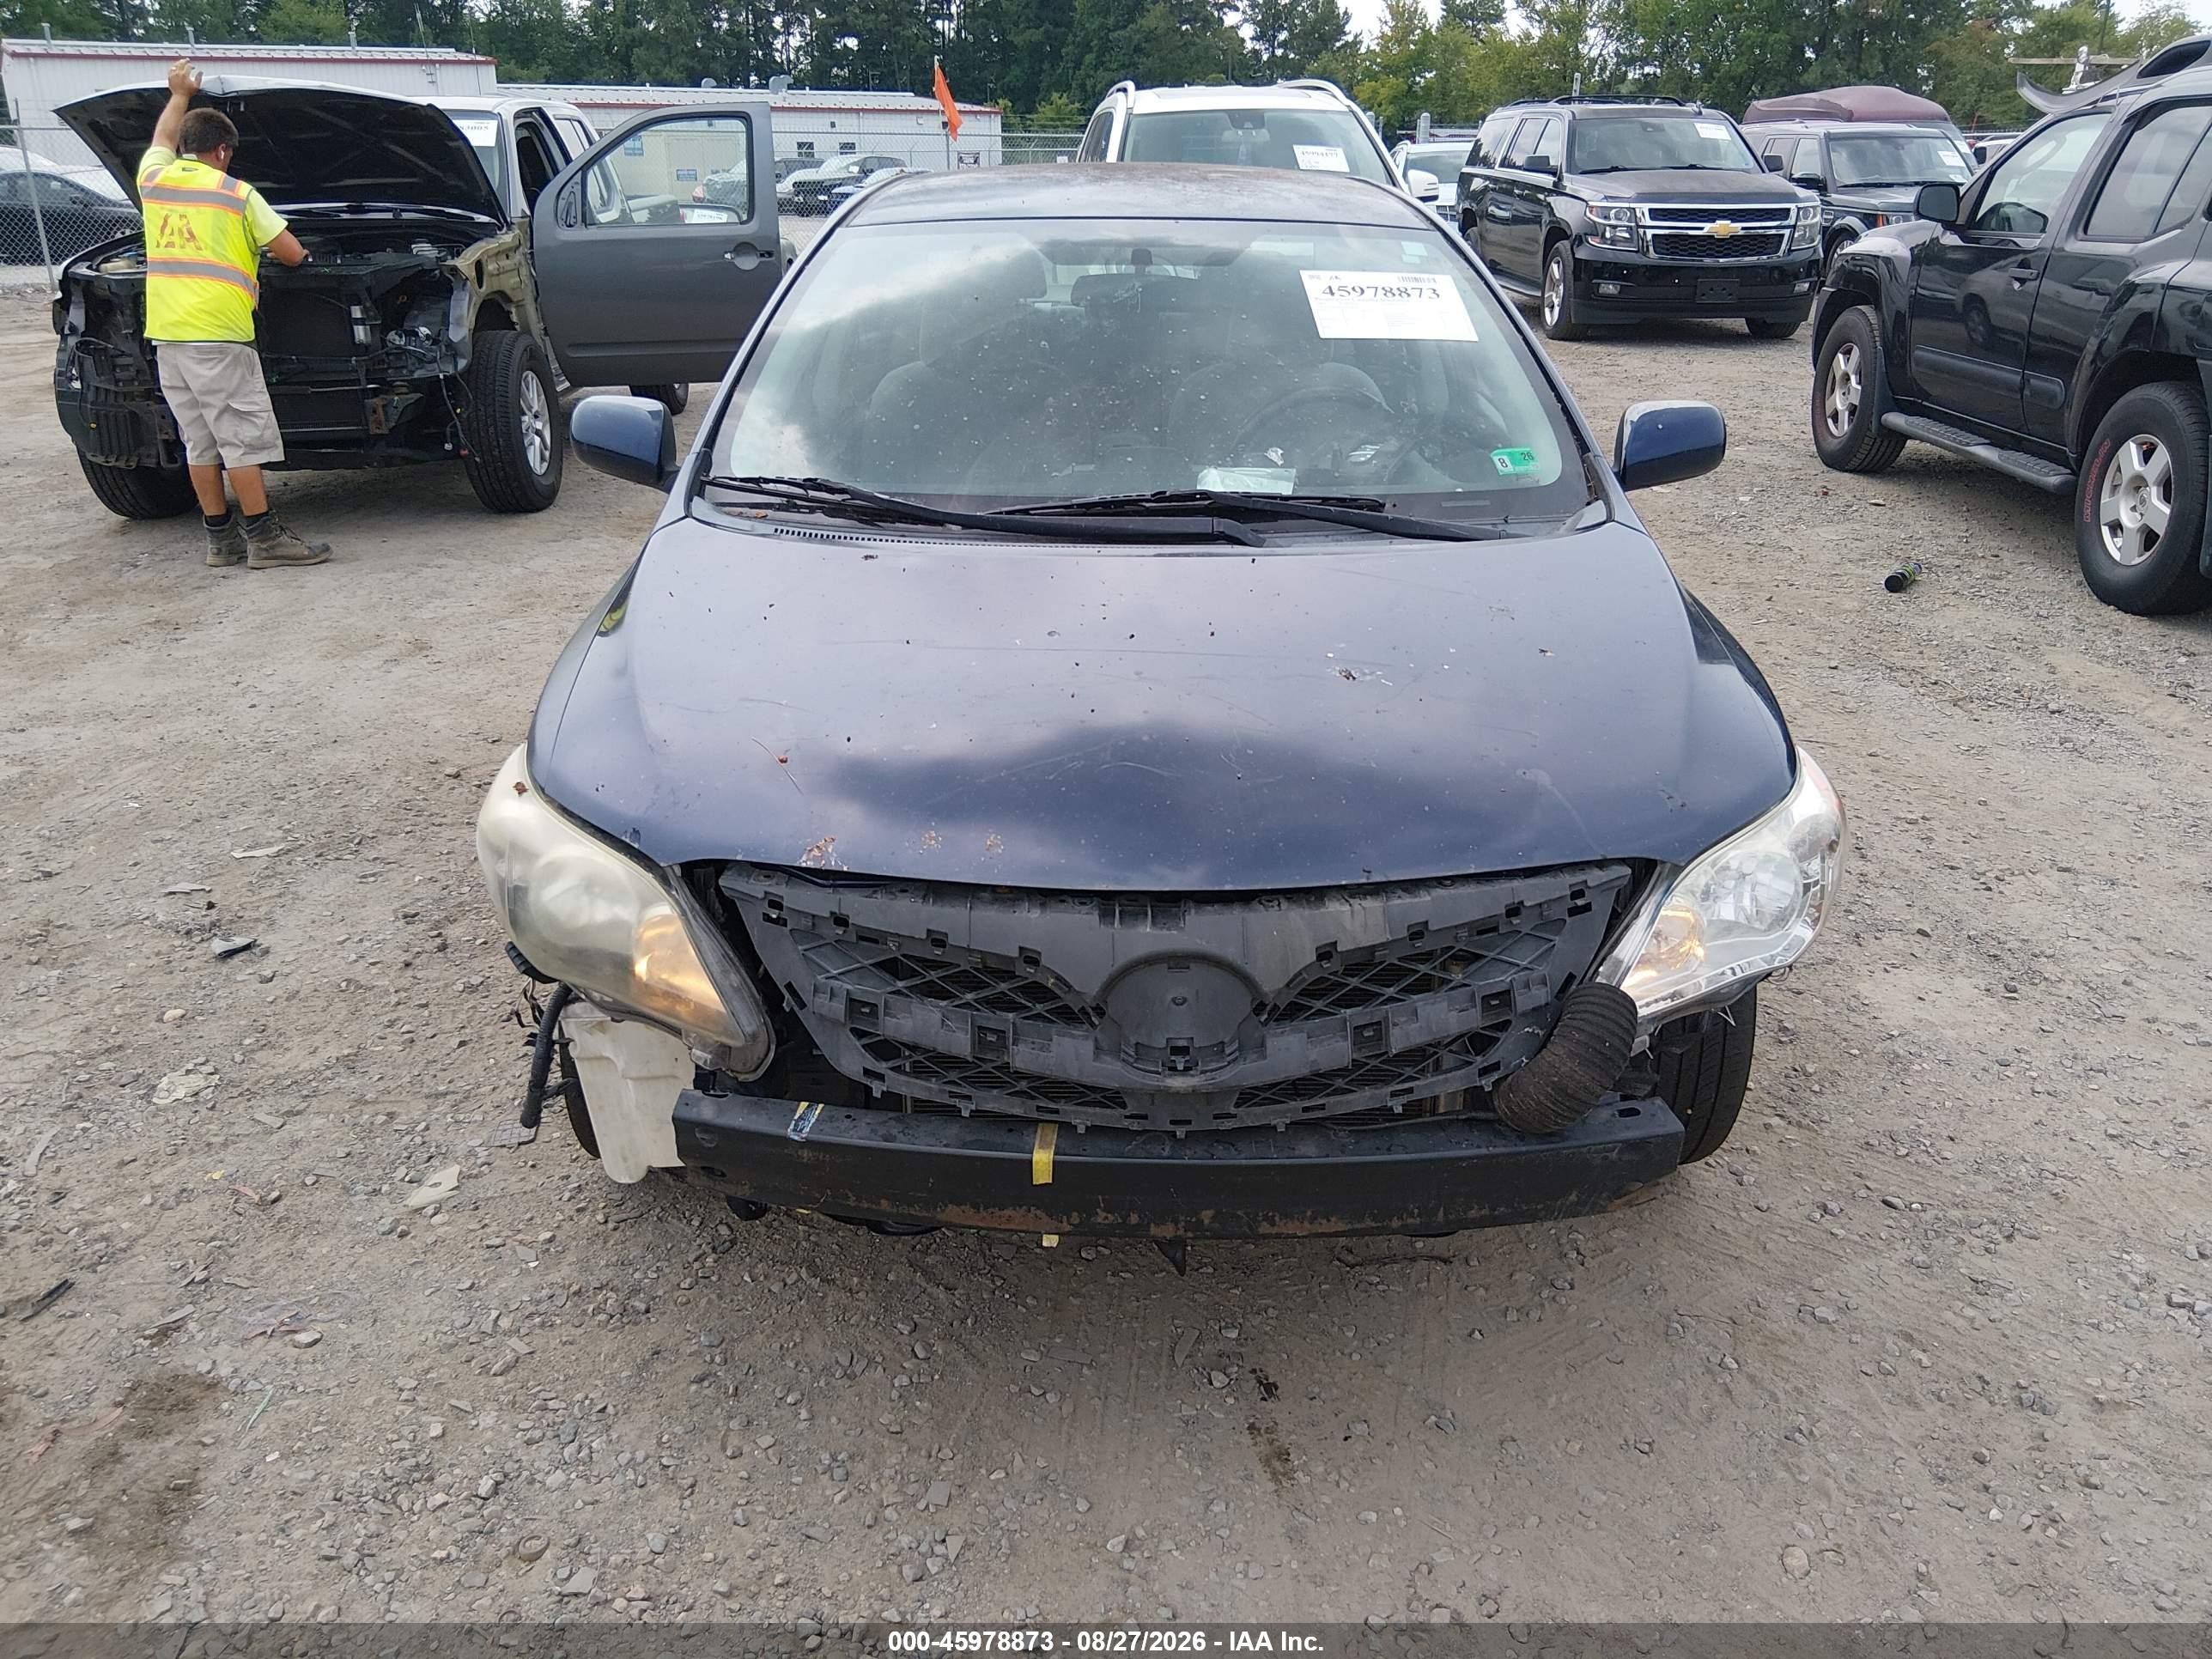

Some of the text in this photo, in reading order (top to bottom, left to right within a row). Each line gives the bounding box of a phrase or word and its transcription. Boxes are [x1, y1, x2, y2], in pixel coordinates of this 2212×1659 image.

[1322, 284, 1441, 300] 45978873
[1520, 452, 1534, 461] 26
[1498, 458, 1509, 468] 8
